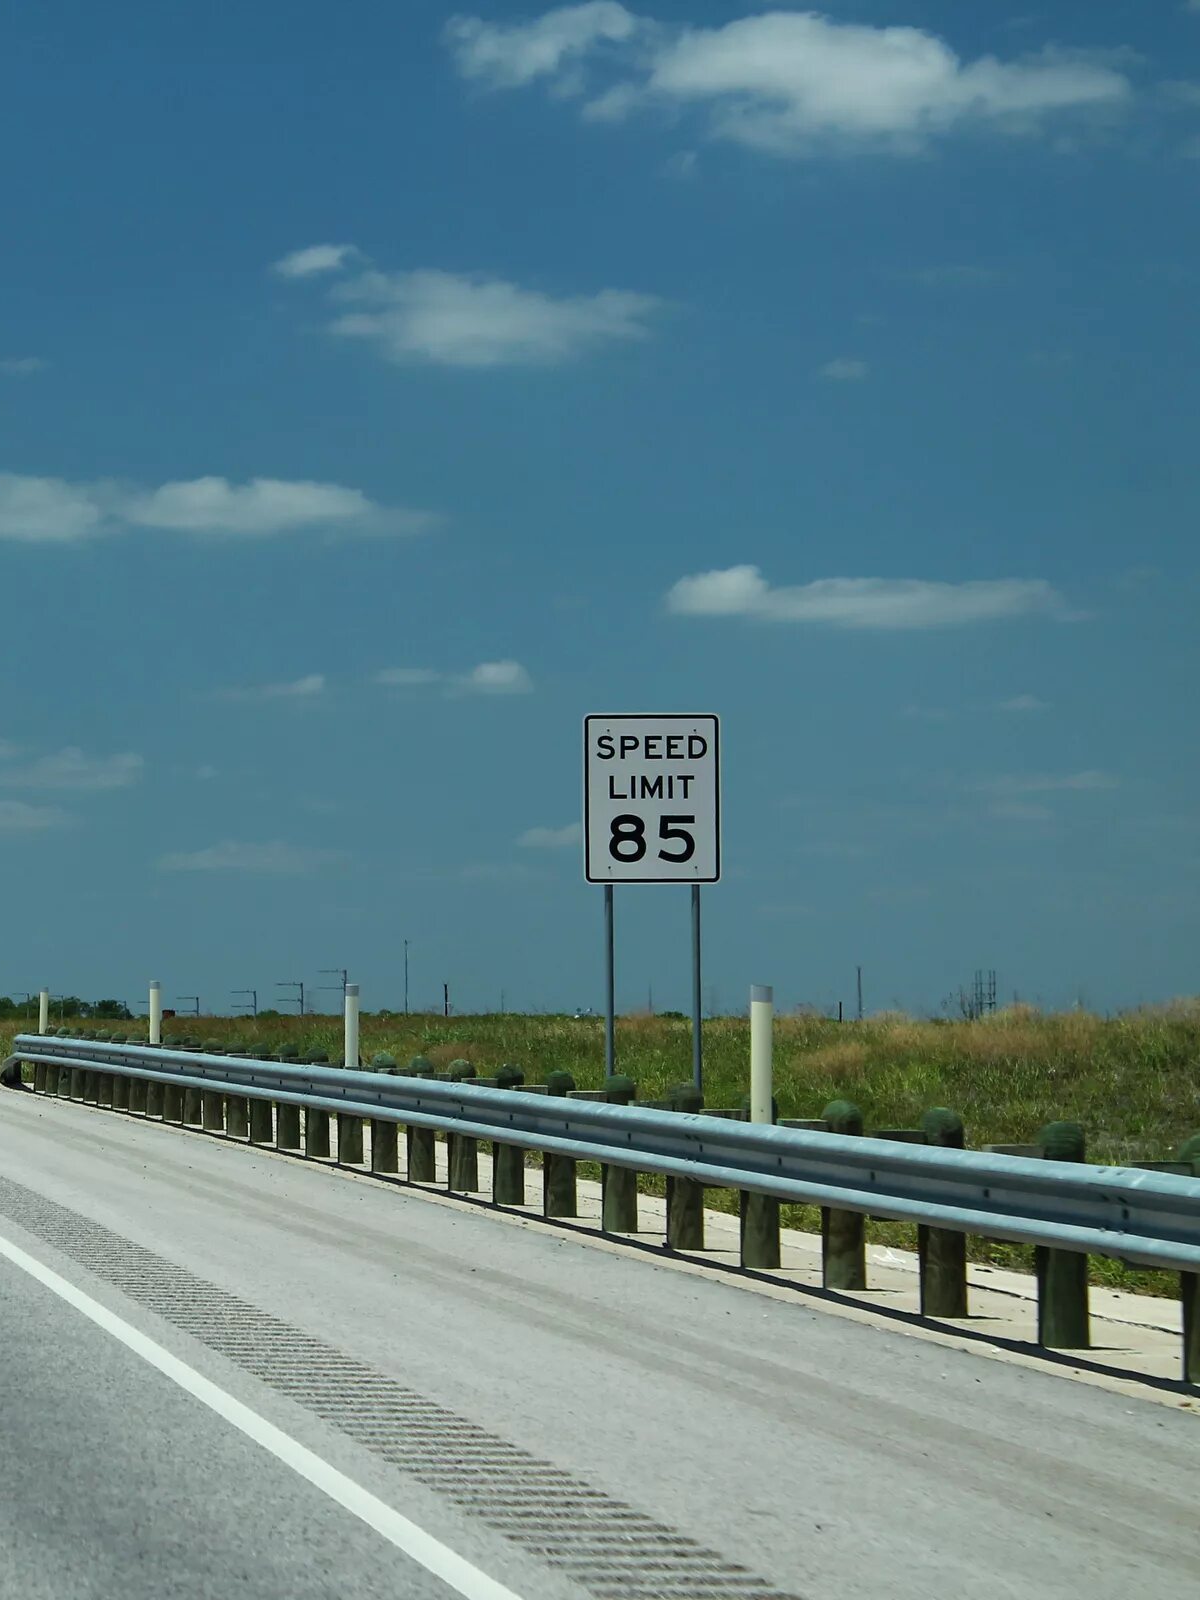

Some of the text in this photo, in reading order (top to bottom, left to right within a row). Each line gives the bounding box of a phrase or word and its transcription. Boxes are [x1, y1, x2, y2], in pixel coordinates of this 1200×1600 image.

[596, 735, 707, 760] SPEED
[609, 775, 695, 799] LIMIT
[609, 814, 695, 863] 85
